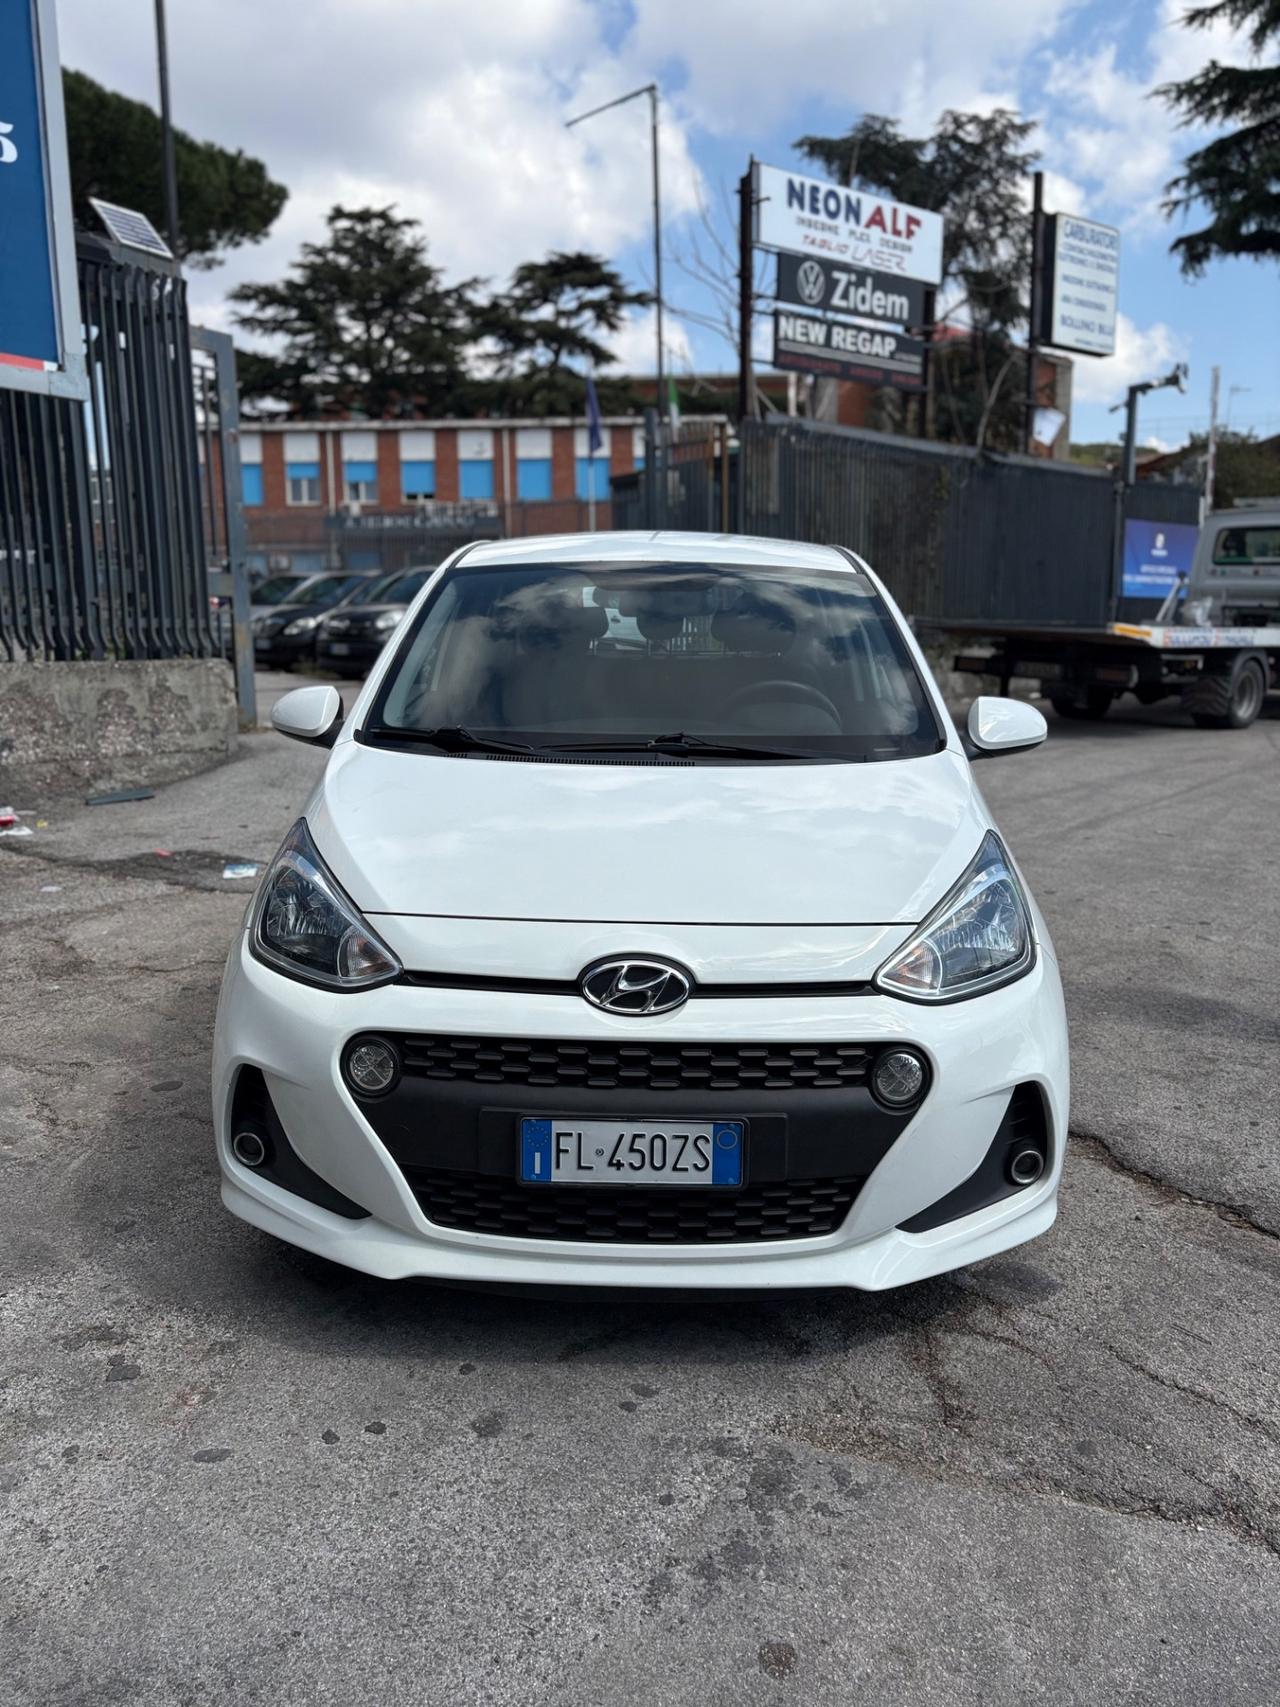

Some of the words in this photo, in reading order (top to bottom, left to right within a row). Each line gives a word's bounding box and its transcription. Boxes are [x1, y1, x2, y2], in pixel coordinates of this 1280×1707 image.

[830, 270, 909, 320] Zidem
[778, 314, 828, 346] NEW
[831, 325, 897, 359] REGAP
[555, 1131, 594, 1170] FL
